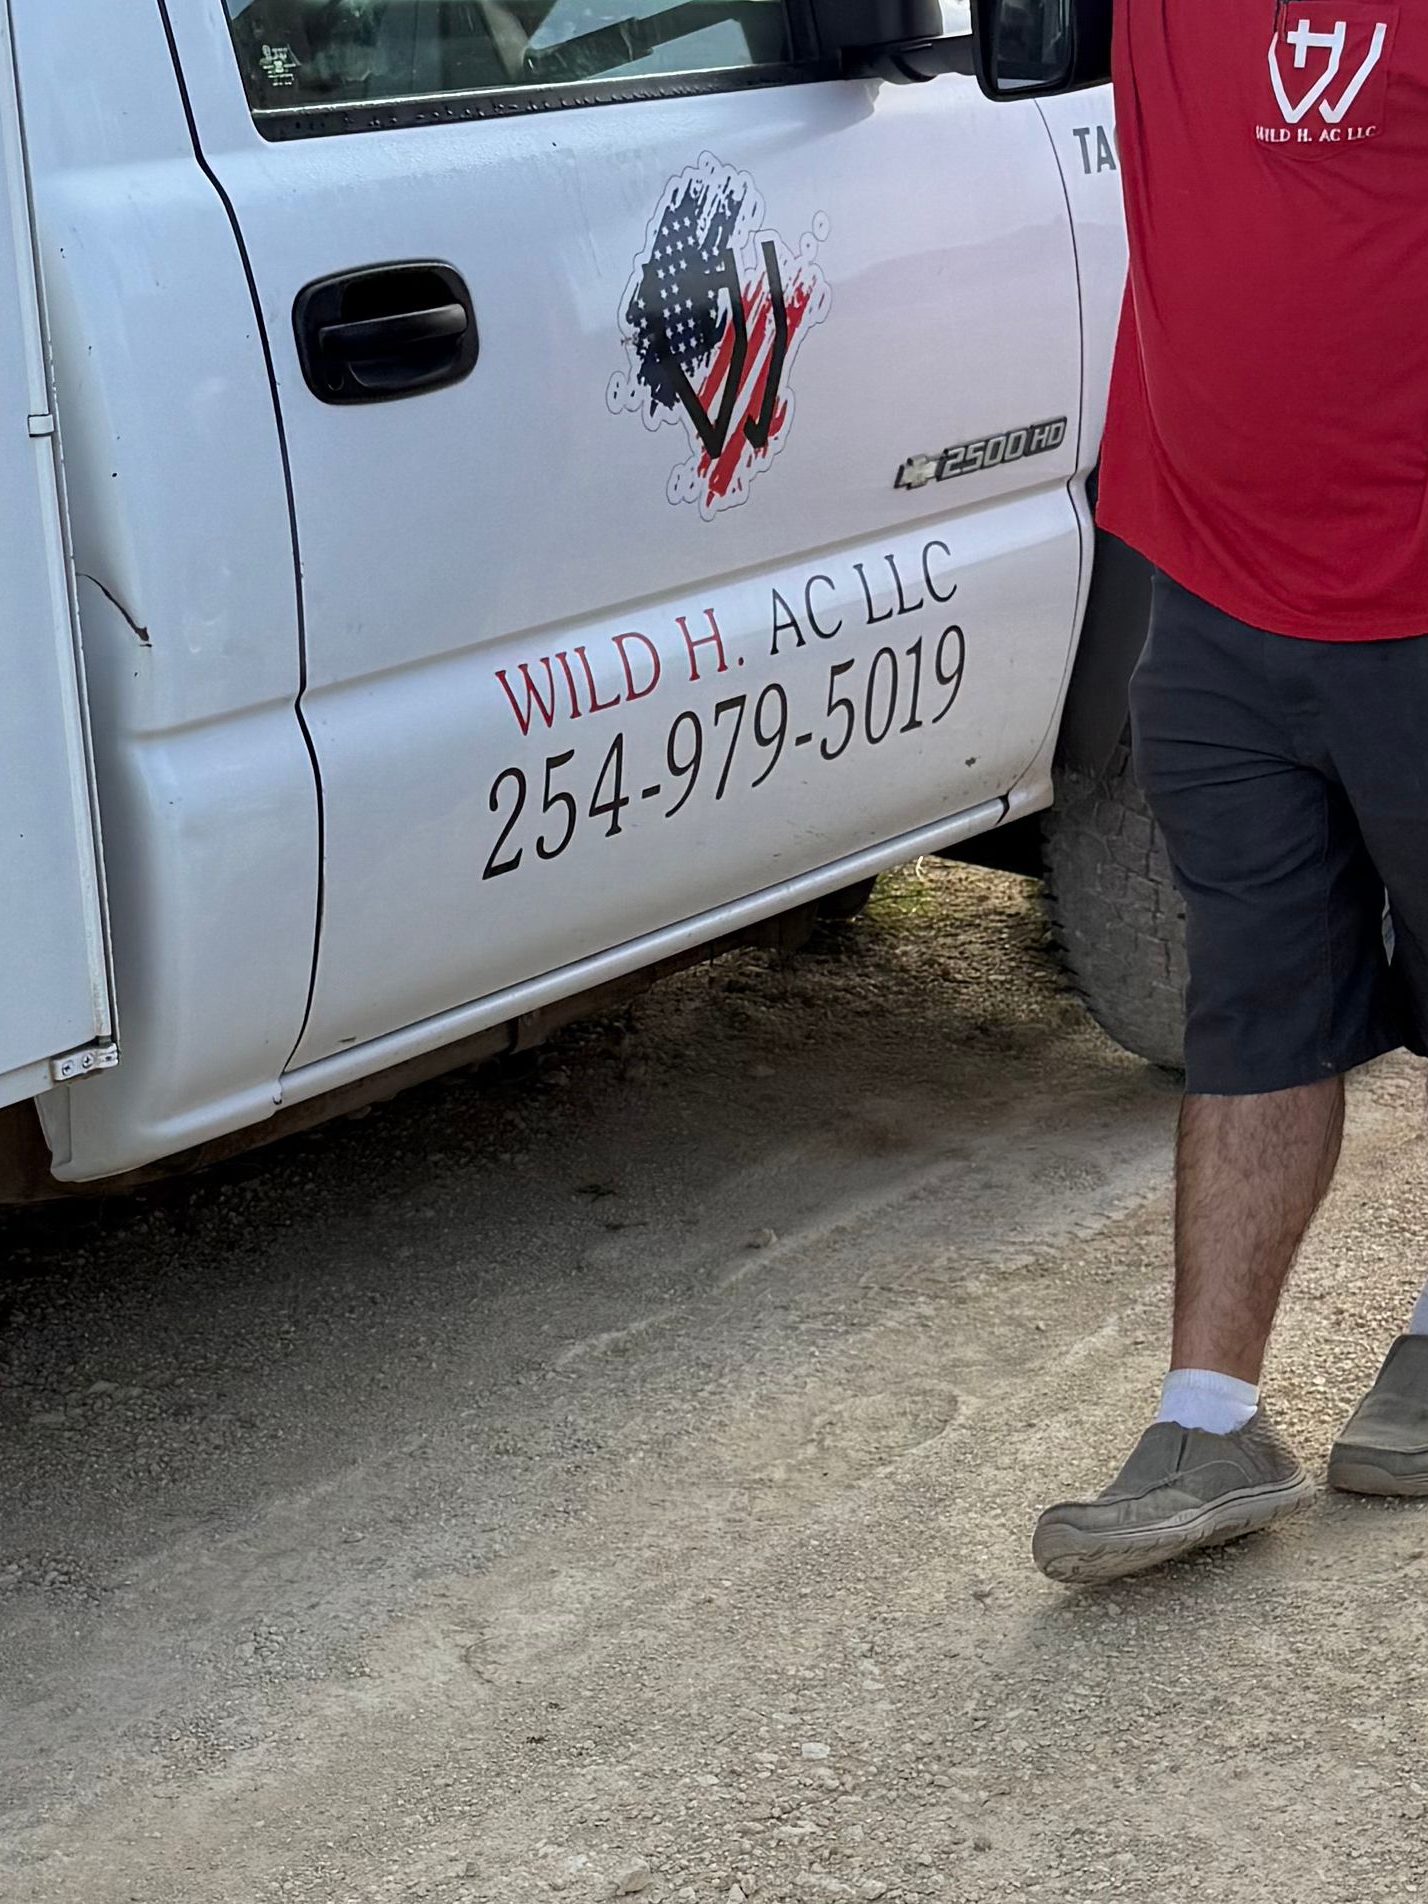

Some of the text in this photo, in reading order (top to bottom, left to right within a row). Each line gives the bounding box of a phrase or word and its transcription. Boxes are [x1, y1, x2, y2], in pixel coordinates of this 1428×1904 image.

[1072, 125, 1118, 175] TA
[1296, 128, 1314, 143] H.
[1318, 128, 1342, 143] AC
[1346, 125, 1377, 141] LLC
[941, 430, 1027, 480] 2500
[493, 540, 958, 736] WILD H. AC LLC
[481, 624, 966, 881] 254-979-5019
